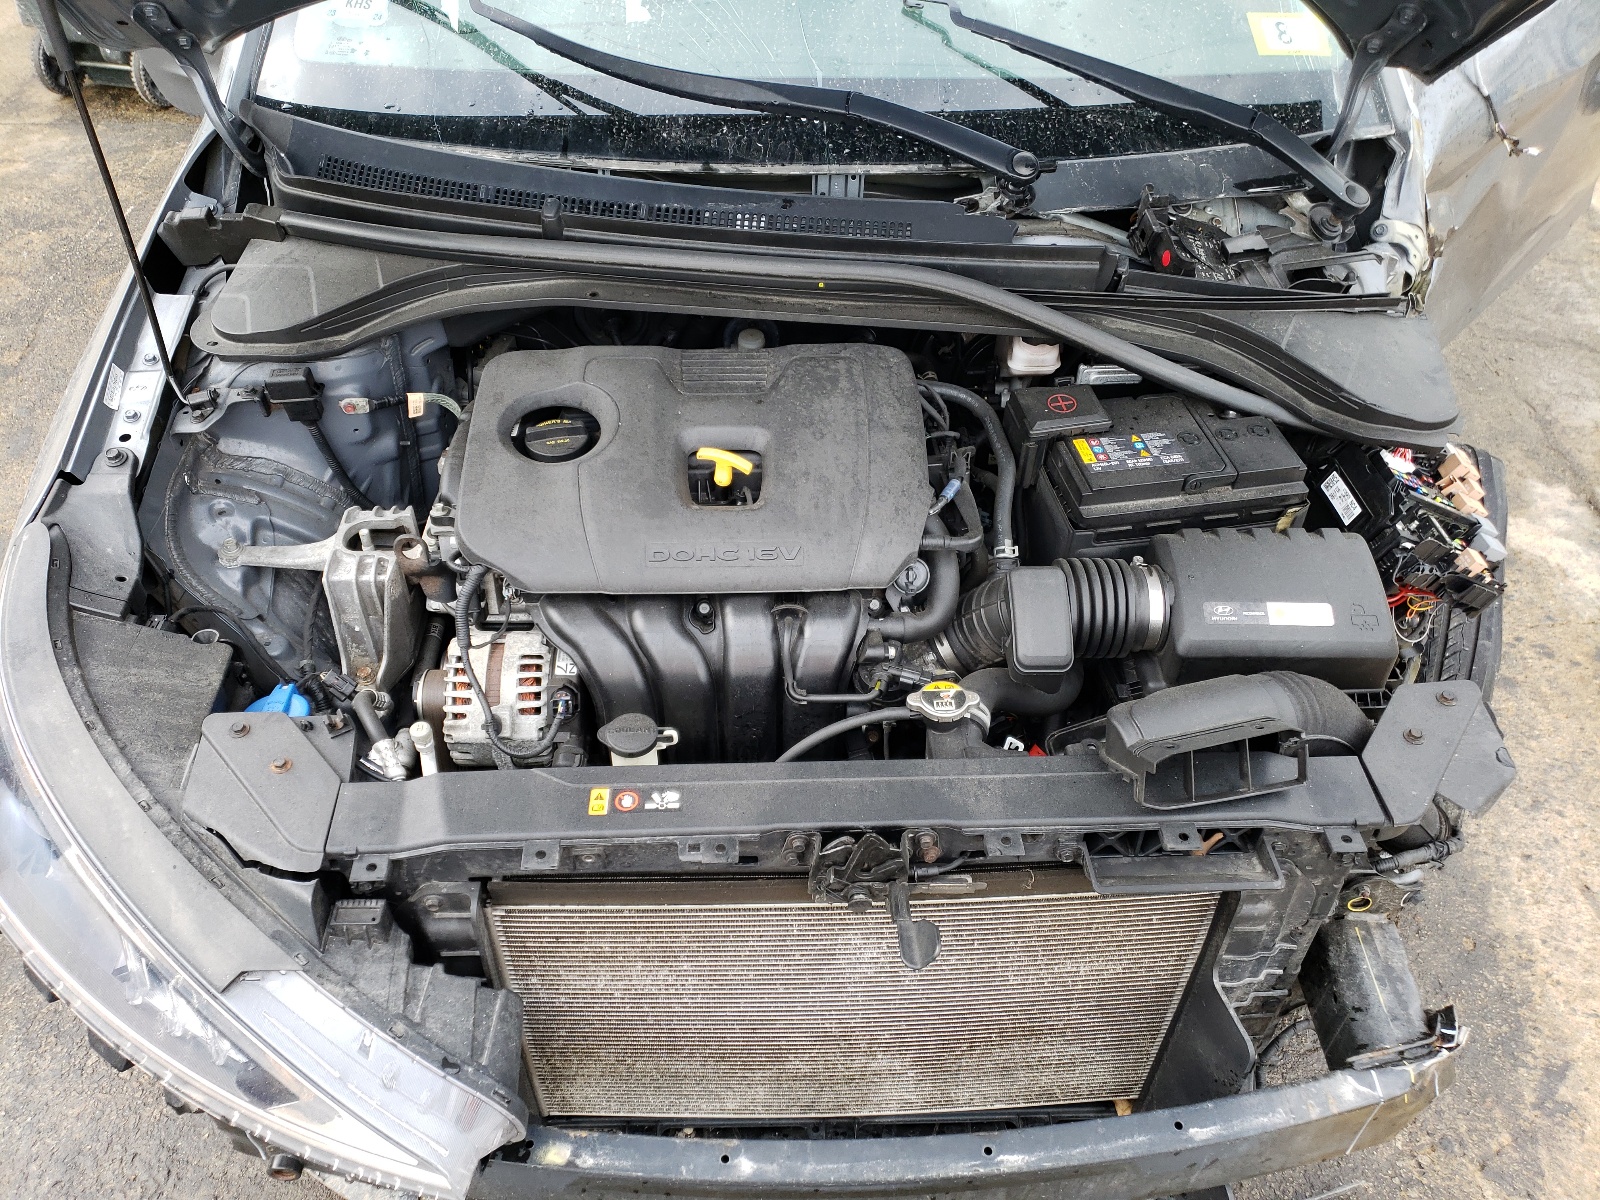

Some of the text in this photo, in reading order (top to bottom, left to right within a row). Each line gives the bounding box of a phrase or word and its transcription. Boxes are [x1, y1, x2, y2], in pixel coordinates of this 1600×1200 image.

[346, 0, 372, 9] KHS
[648, 546, 802, 562] DOHC 16V
